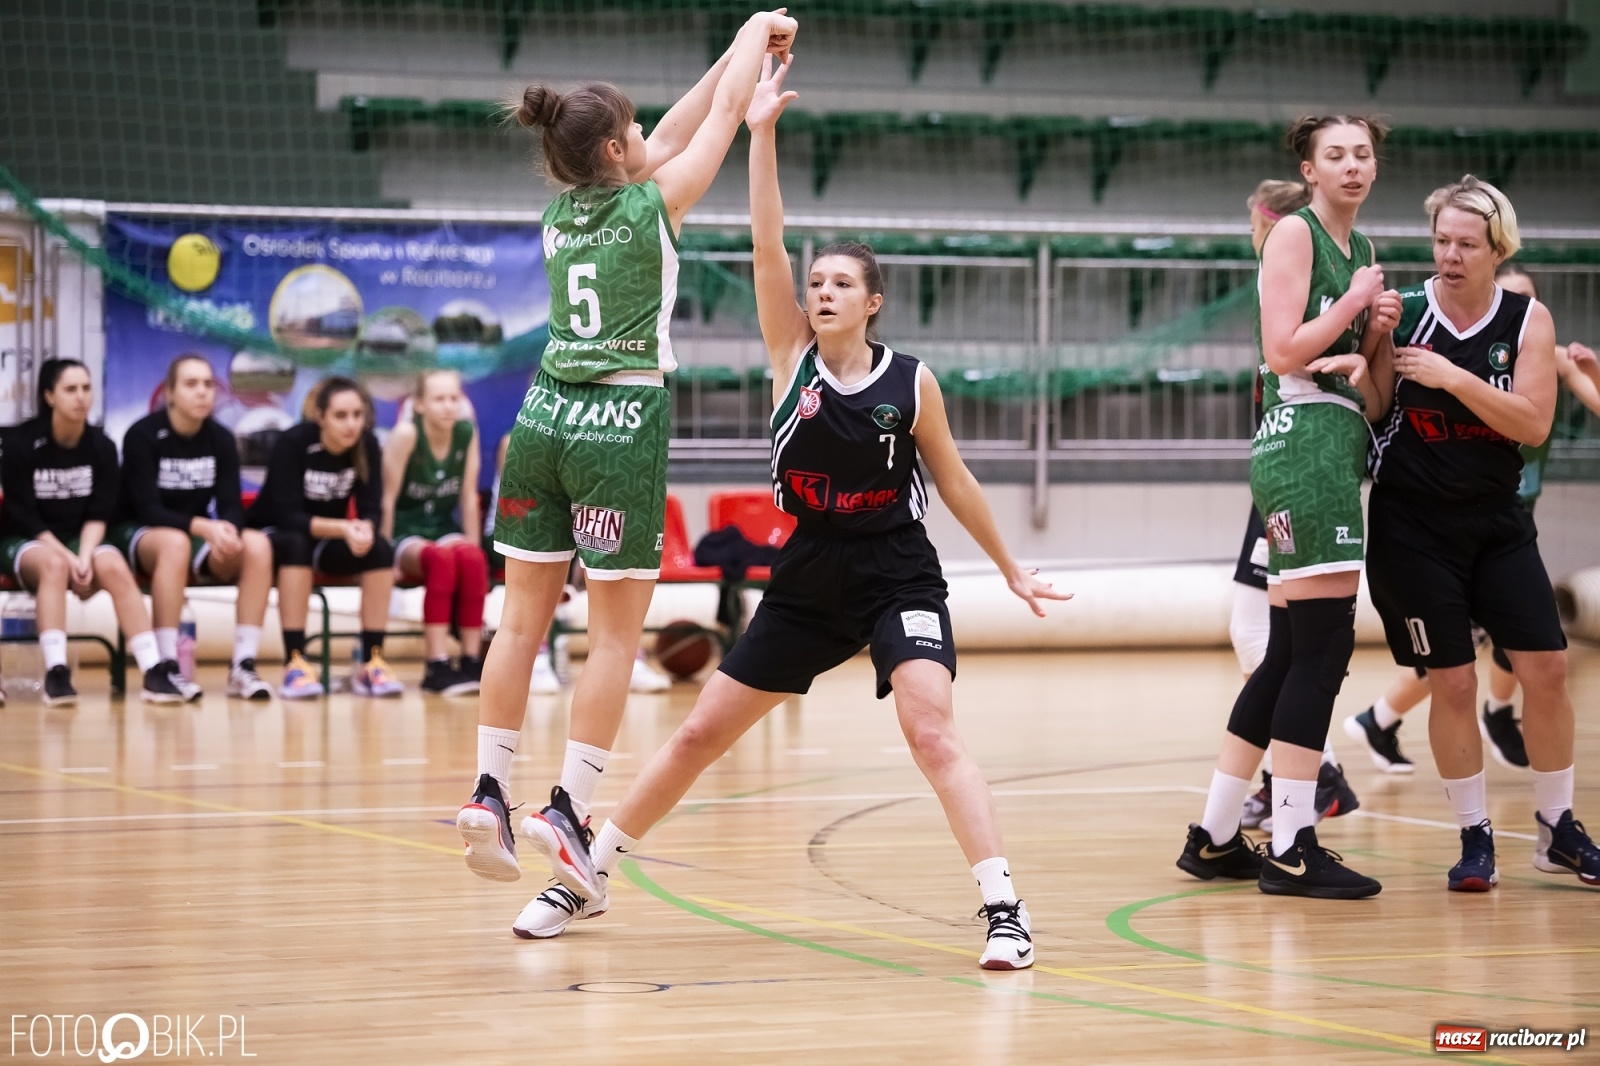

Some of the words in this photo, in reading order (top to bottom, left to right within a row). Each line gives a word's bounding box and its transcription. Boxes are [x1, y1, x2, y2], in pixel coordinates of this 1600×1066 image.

[568, 263, 602, 339] 5
[879, 433, 897, 470] 7
[789, 475, 823, 506] K
[836, 489, 898, 510] KAMAN
[1405, 617, 1431, 656] 10
